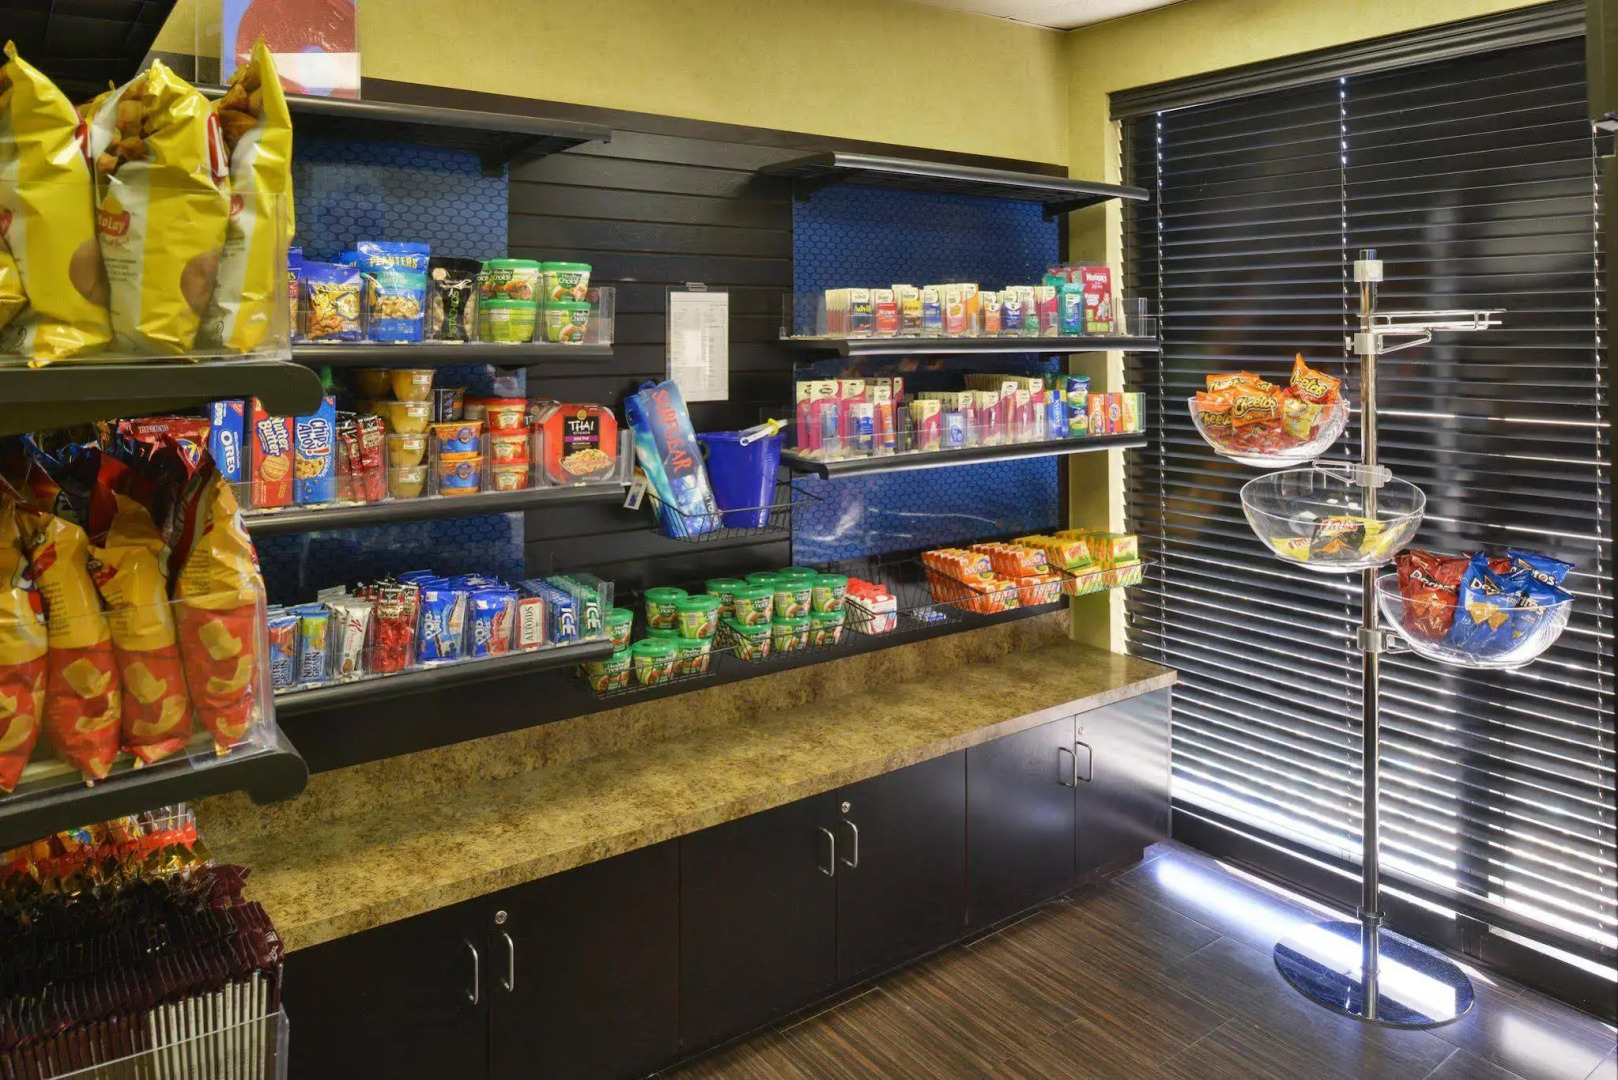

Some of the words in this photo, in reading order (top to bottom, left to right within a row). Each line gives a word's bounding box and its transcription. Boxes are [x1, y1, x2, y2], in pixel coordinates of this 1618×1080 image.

[368, 254, 420, 269] PLANTERS
[1233, 396, 1278, 417] Cheetos
[258, 420, 282, 456] Butter
[309, 420, 328, 449] Chips
[567, 420, 595, 432] THAI
[220, 430, 236, 474] OREO
[525, 606, 534, 642] ALTOIDS
[561, 607, 576, 636] ICE
[586, 602, 602, 630] ICE
[303, 652, 312, 678] NUTRI
[312, 651, 320, 678] GRAIN
